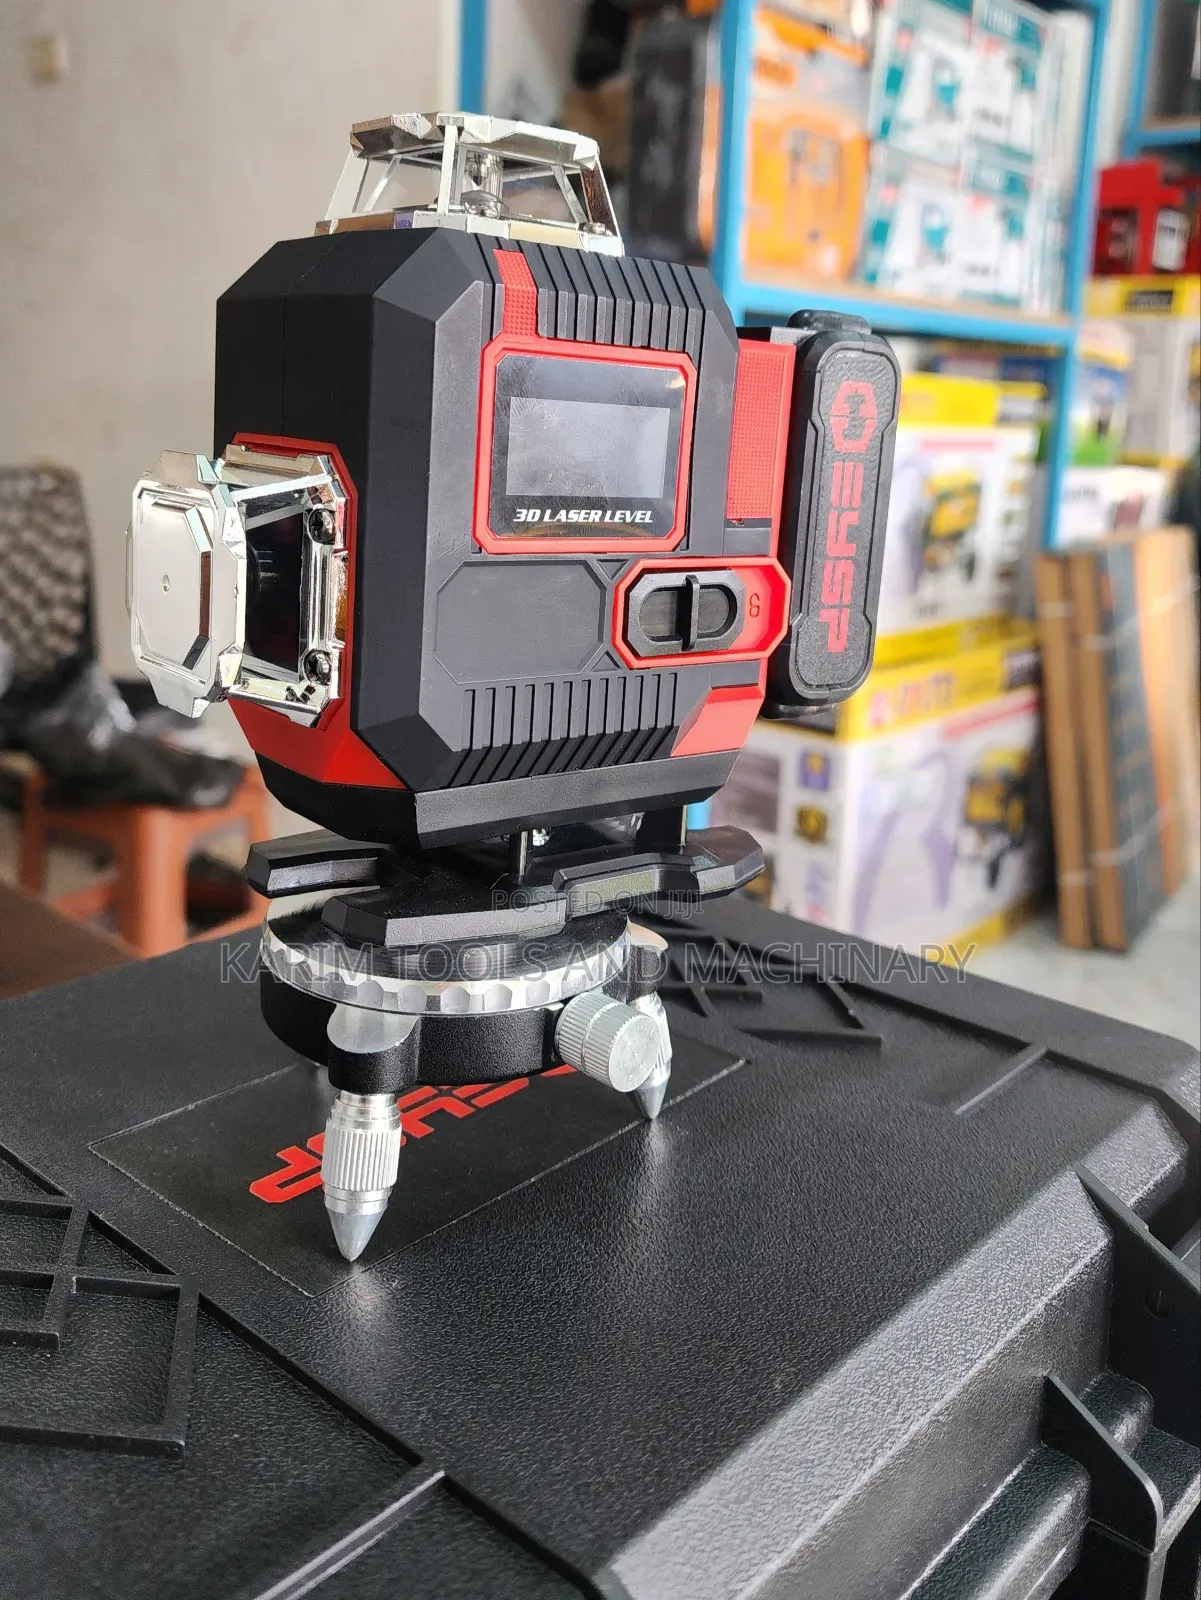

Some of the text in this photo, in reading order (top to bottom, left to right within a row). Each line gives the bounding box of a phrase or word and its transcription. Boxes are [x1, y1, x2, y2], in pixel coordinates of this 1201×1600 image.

[513, 508, 654, 523] 3D LASER LEVEL
